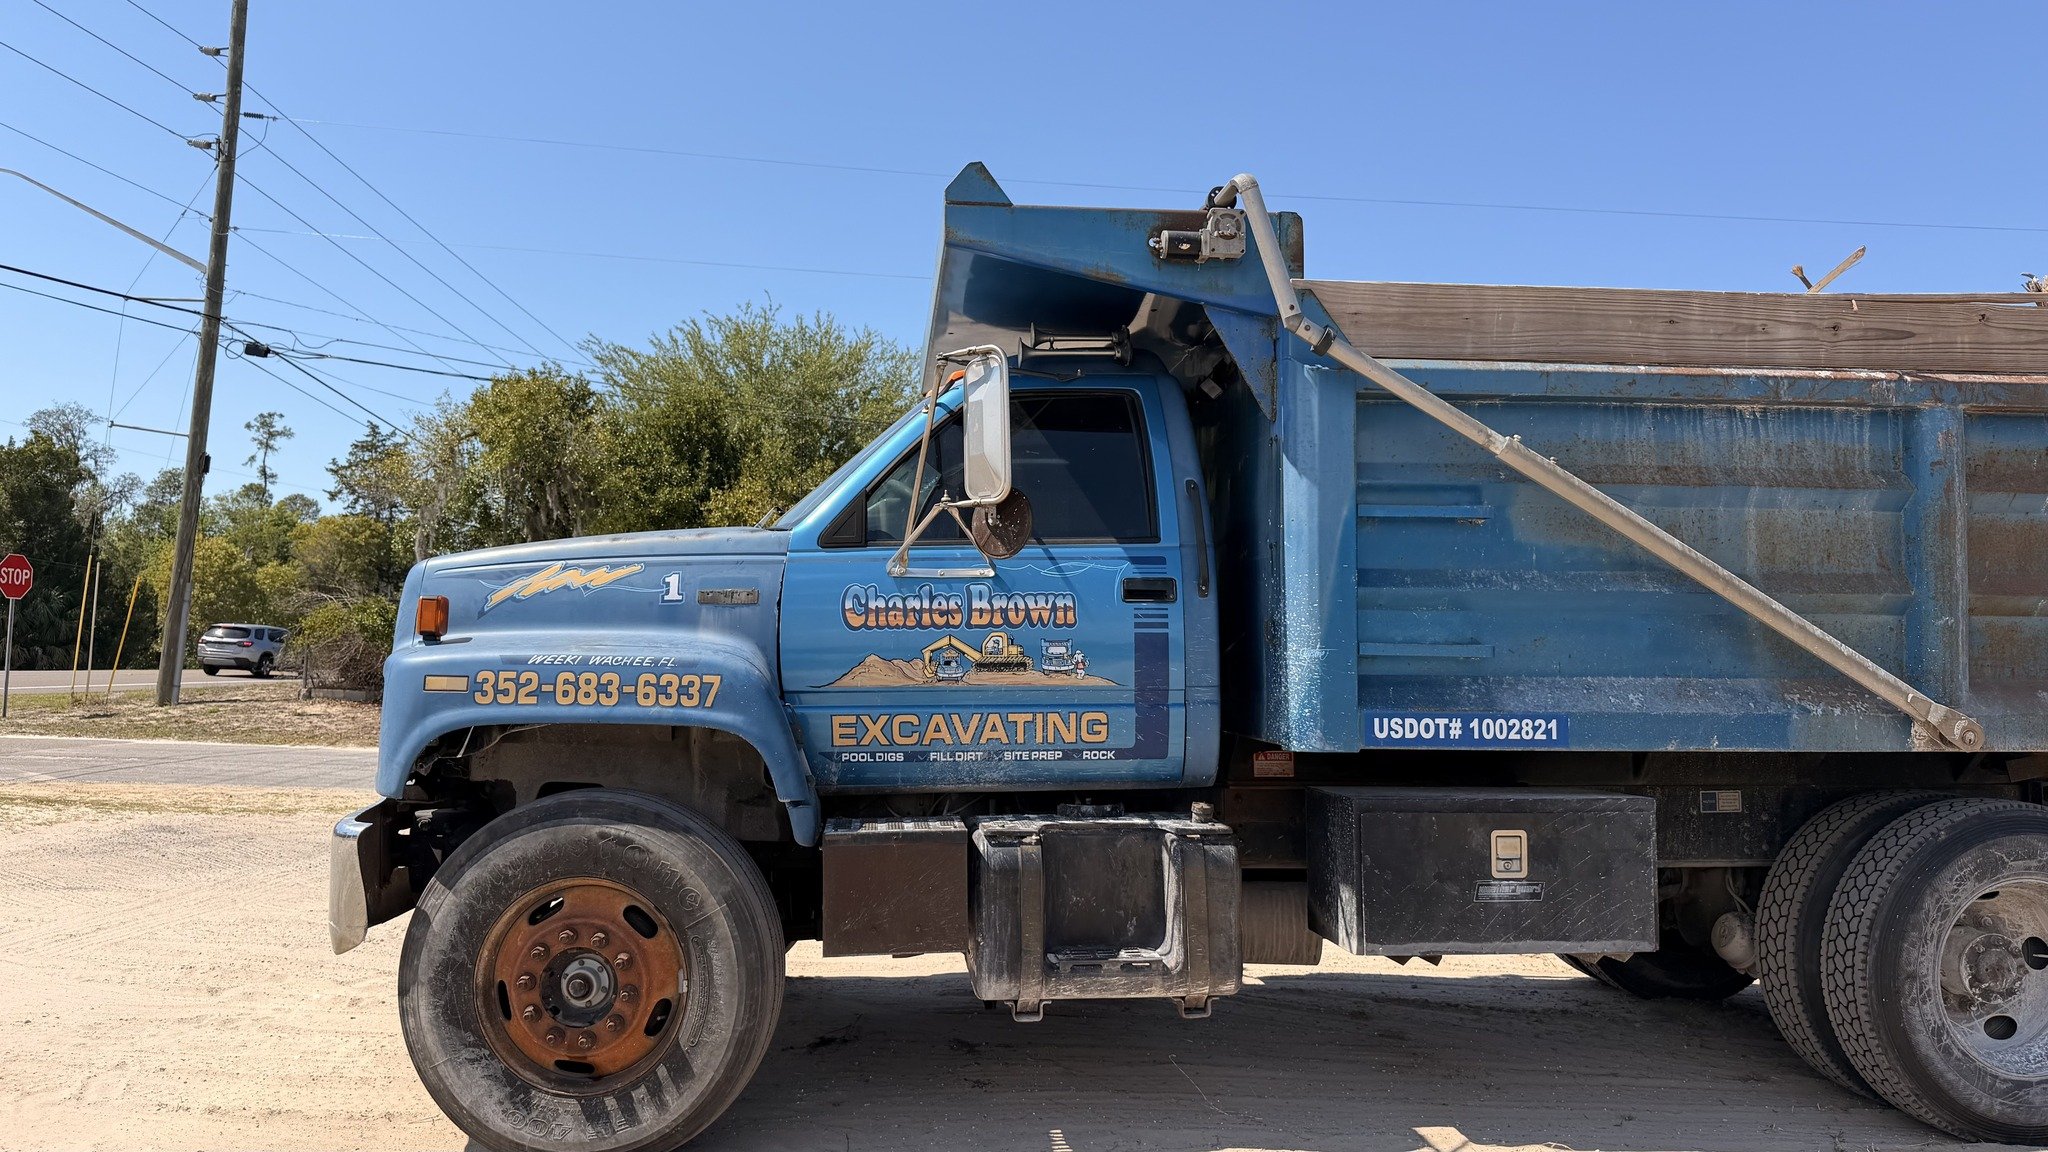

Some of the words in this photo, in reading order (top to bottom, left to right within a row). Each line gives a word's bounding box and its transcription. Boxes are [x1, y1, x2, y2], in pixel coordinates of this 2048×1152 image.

[0, 567, 30, 585] STOP
[661, 571, 684, 603] 1
[841, 583, 963, 630] Charles
[966, 583, 1077, 630] Brown
[527, 654, 583, 666] WEEKI
[588, 655, 656, 668] WACHEE,
[657, 656, 679, 668] FL.
[473, 670, 722, 708] 352-683-6337
[831, 711, 1109, 747] EXCAVATING
[1373, 717, 1463, 740] USDOT#
[1469, 717, 1558, 740] 1002821
[841, 752, 874, 762] POOL
[875, 752, 905, 762] DIGS
[929, 752, 954, 762] FILL
[955, 751, 983, 761] DIRT
[1003, 751, 1030, 761] SITE
[1031, 751, 1063, 761] PREP
[1082, 750, 1116, 760] ROCK
[1266, 752, 1290, 761] DANGER
